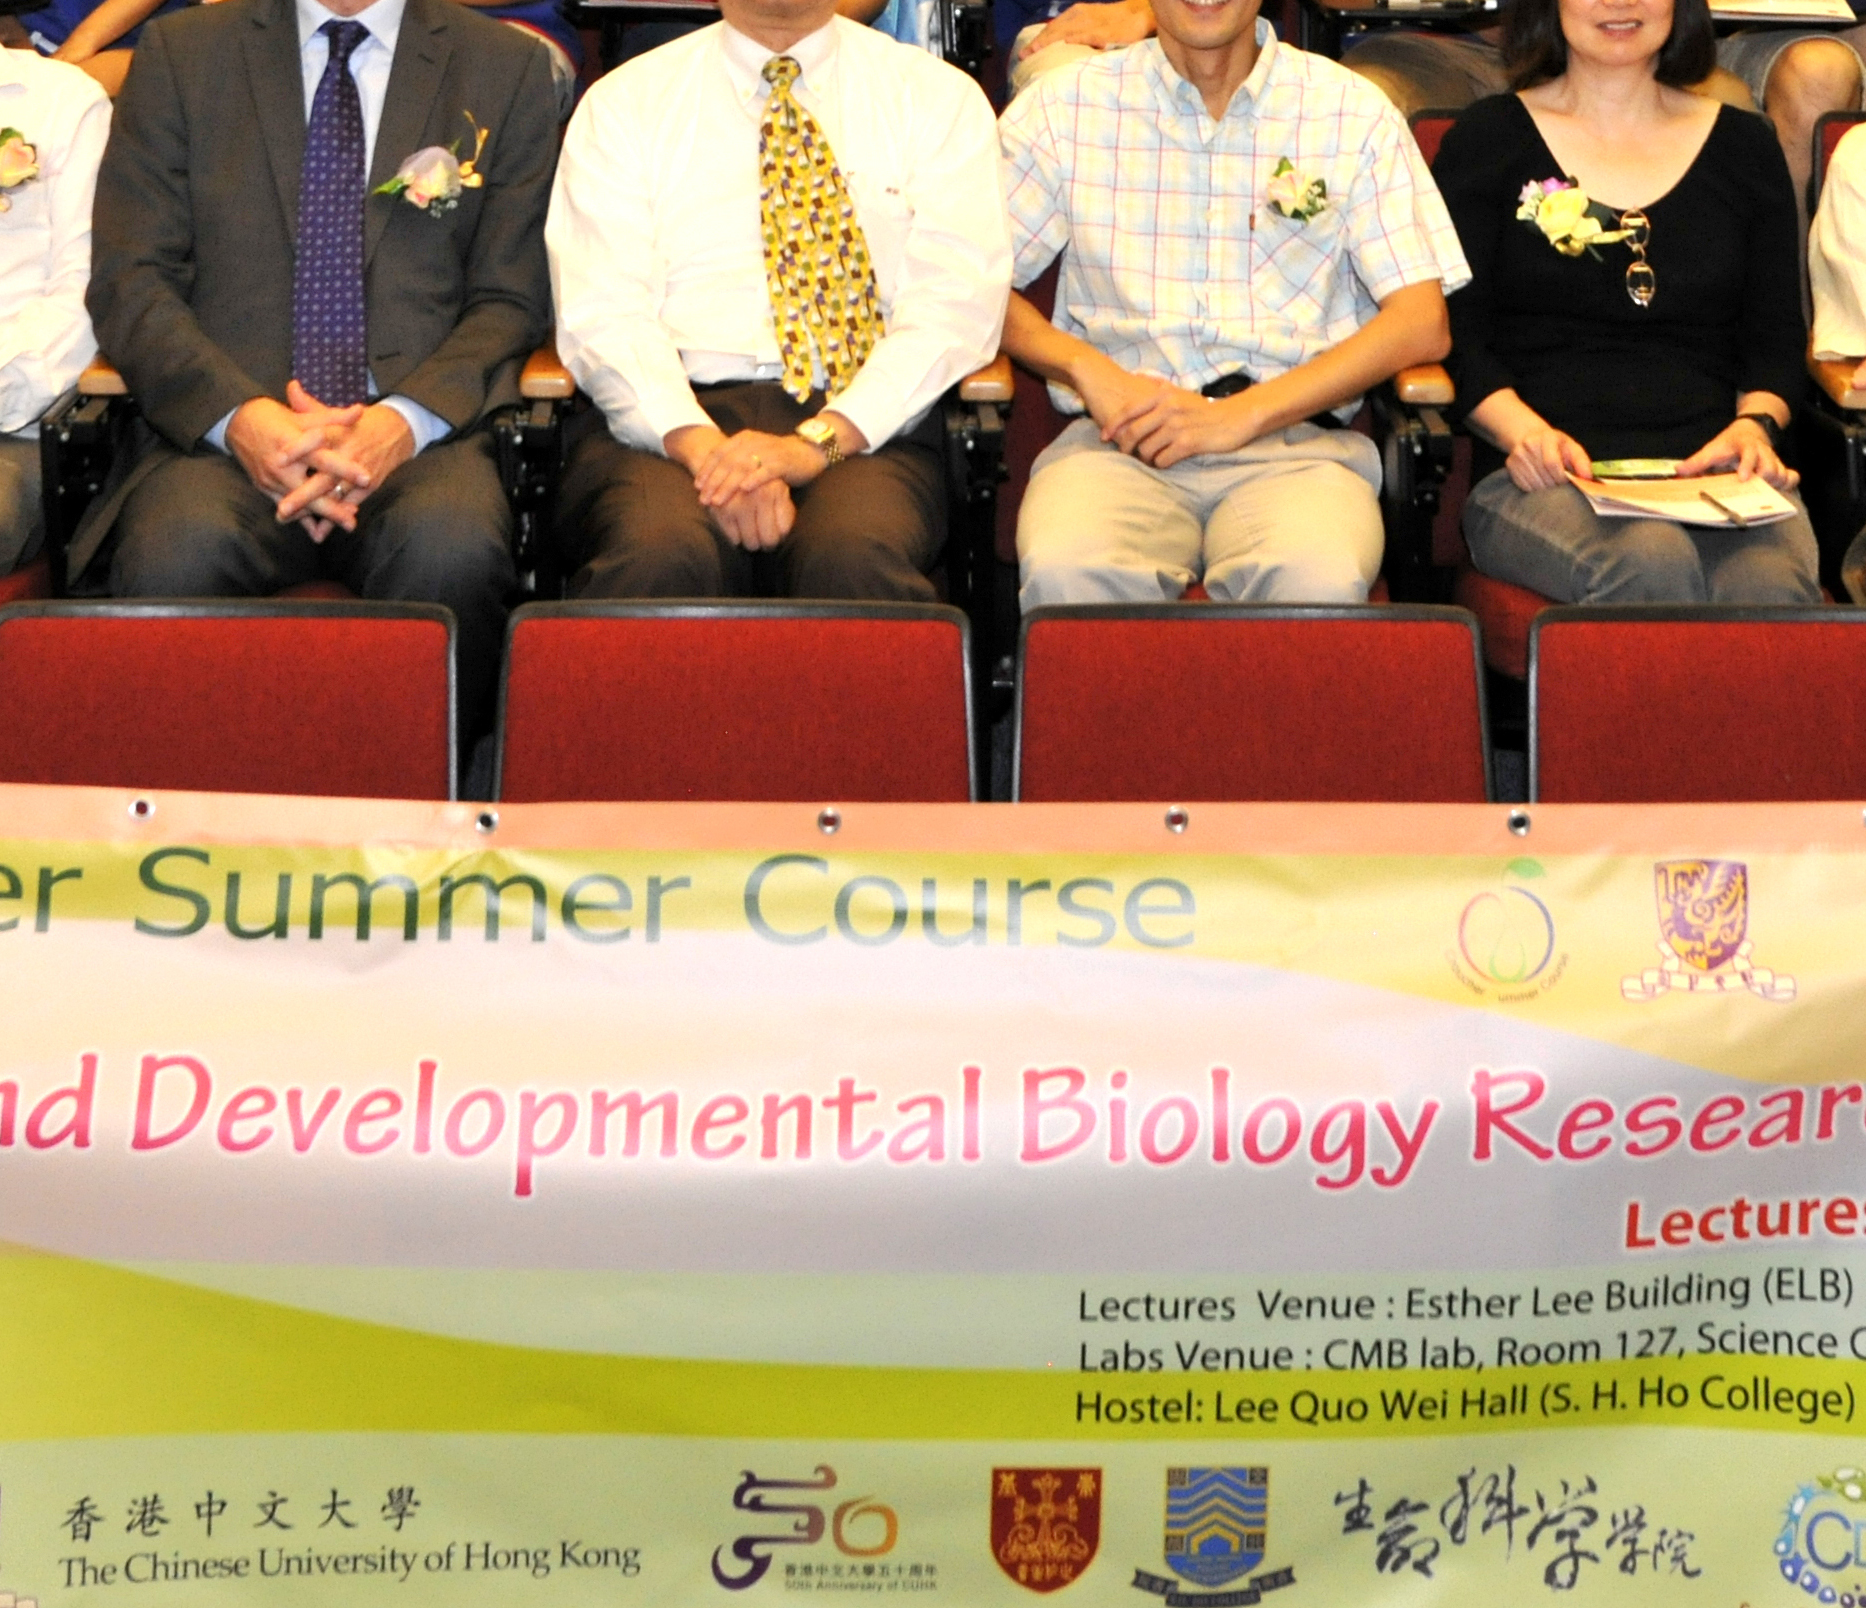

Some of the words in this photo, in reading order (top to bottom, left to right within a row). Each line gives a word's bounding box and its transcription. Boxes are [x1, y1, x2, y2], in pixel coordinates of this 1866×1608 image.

[134, 846, 691, 944] Summer
[744, 853, 1196, 948] Course
[131, 1053, 981, 1198] Developmental
[1021, 1066, 1440, 1192] Biology
[1079, 1290, 1236, 1323] Lectures
[1258, 1290, 1375, 1322] Venue
[1407, 1286, 1521, 1320] Esther
[1533, 1285, 1595, 1318] Lee
[1606, 1271, 1751, 1312] Building
[1763, 1266, 1853, 1306] (ELB)
[1080, 1340, 1163, 1374] Labs
[1177, 1341, 1293, 1373] Venue
[1323, 1337, 1408, 1371] CMB
[1421, 1335, 1484, 1373] lab,
[1497, 1334, 1602, 1368] Room
[1617, 1326, 1686, 1363] 127,
[1697, 1322, 1837, 1359] Science
[1076, 1389, 1204, 1424] Hostel:
[1215, 1390, 1278, 1423] Lee
[1290, 1389, 1368, 1426] Quo
[1380, 1388, 1449, 1421] Wei
[1461, 1384, 1528, 1419] Hall
[1540, 1380, 1580, 1417] (S.
[1593, 1378, 1627, 1411] H.
[1637, 1376, 1689, 1409] Ho
[1700, 1374, 1856, 1423] College)
[61, 1484, 422, 1543] 香港中文大學
[59, 1555, 117, 1588] The
[125, 1551, 250, 1584] Chinese
[259, 1546, 419, 1583] University
[423, 1541, 457, 1573] of
[465, 1541, 551, 1579] Hong
[560, 1539, 641, 1576] Kong
